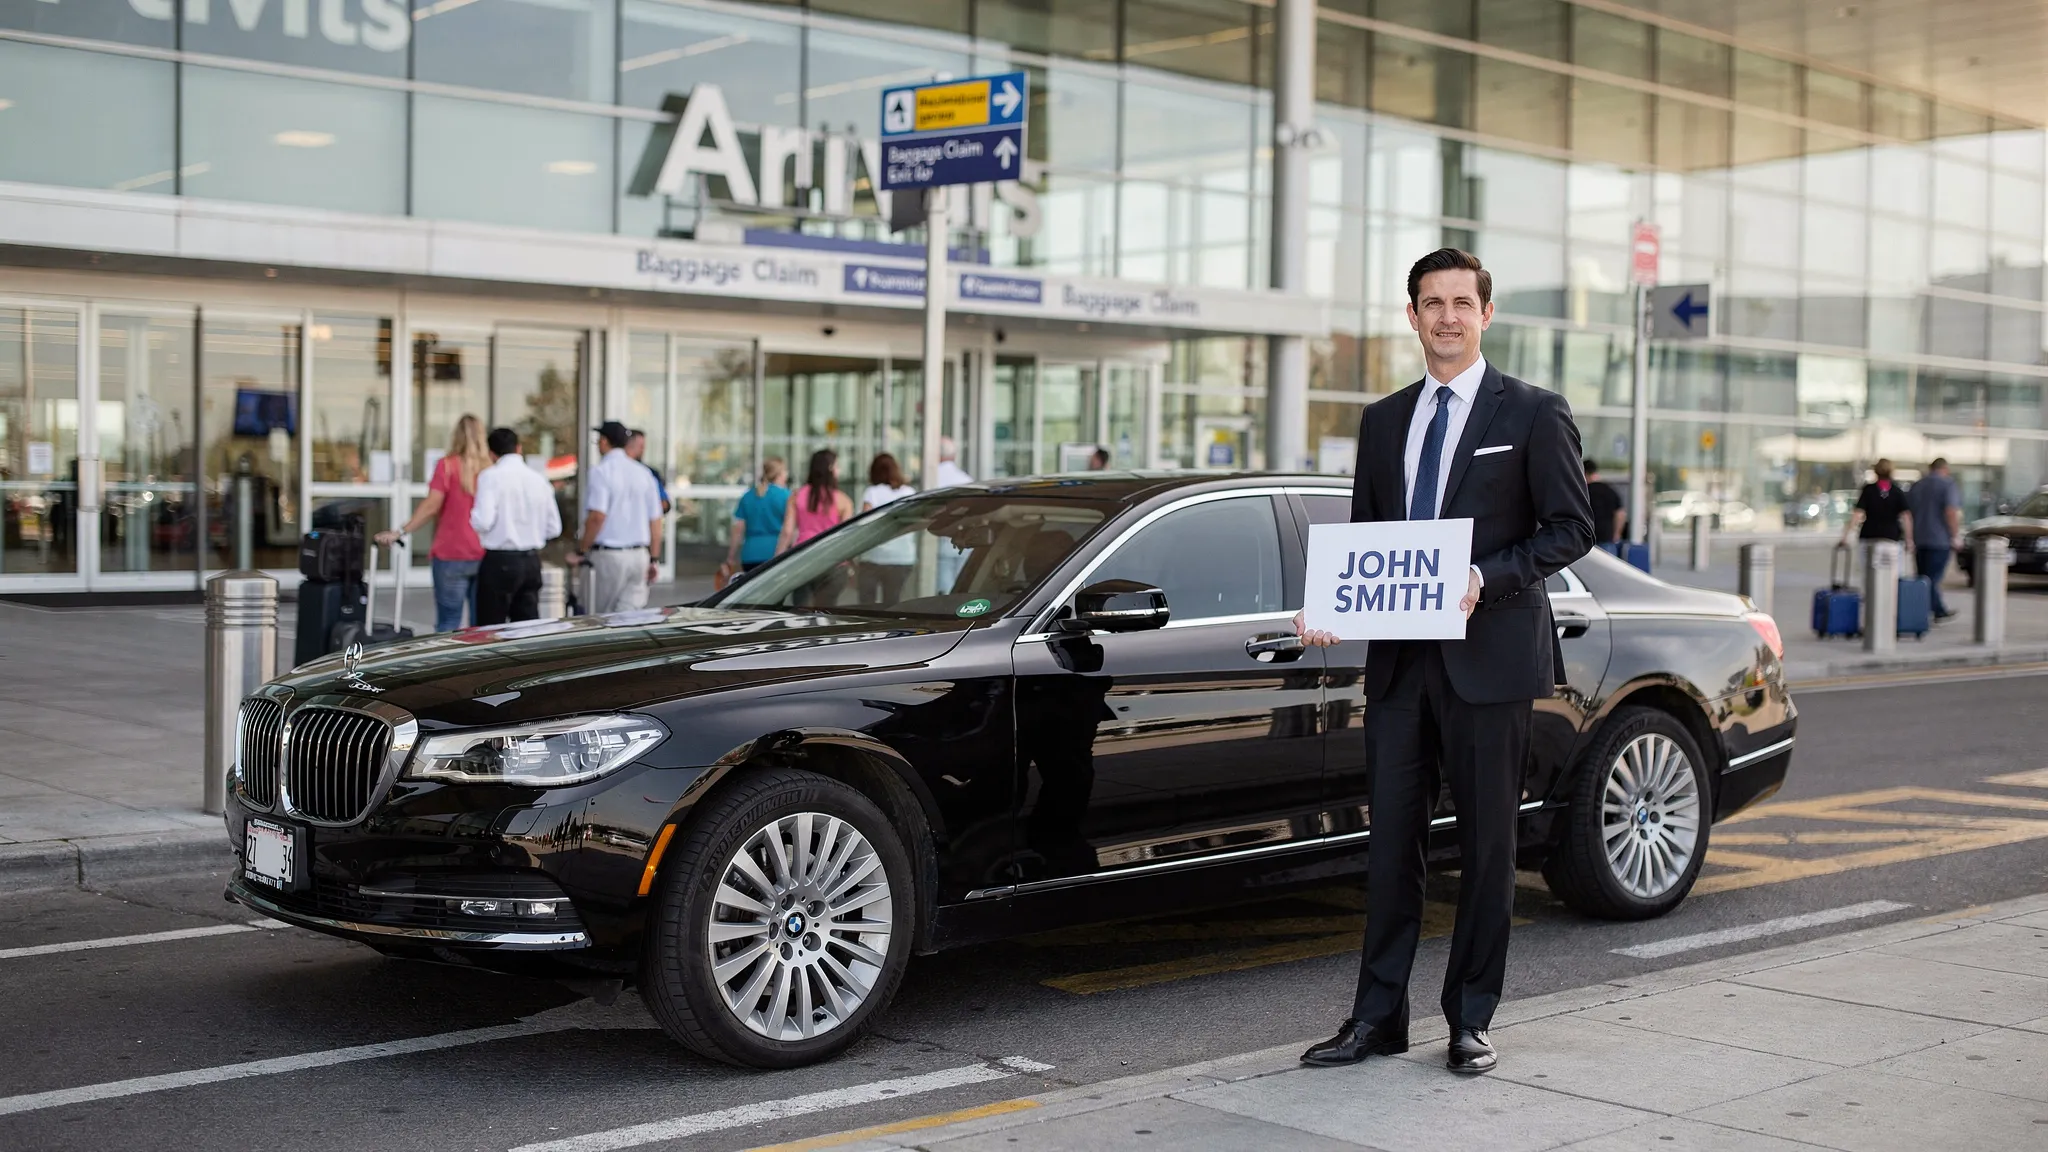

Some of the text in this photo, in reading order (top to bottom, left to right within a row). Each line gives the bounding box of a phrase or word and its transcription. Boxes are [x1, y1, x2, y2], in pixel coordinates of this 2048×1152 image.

[943, 139, 984, 160] Claim
[636, 250, 819, 287] Baggage Claim
[1338, 549, 1440, 580] JOHN
[1334, 582, 1444, 613] SMITH
